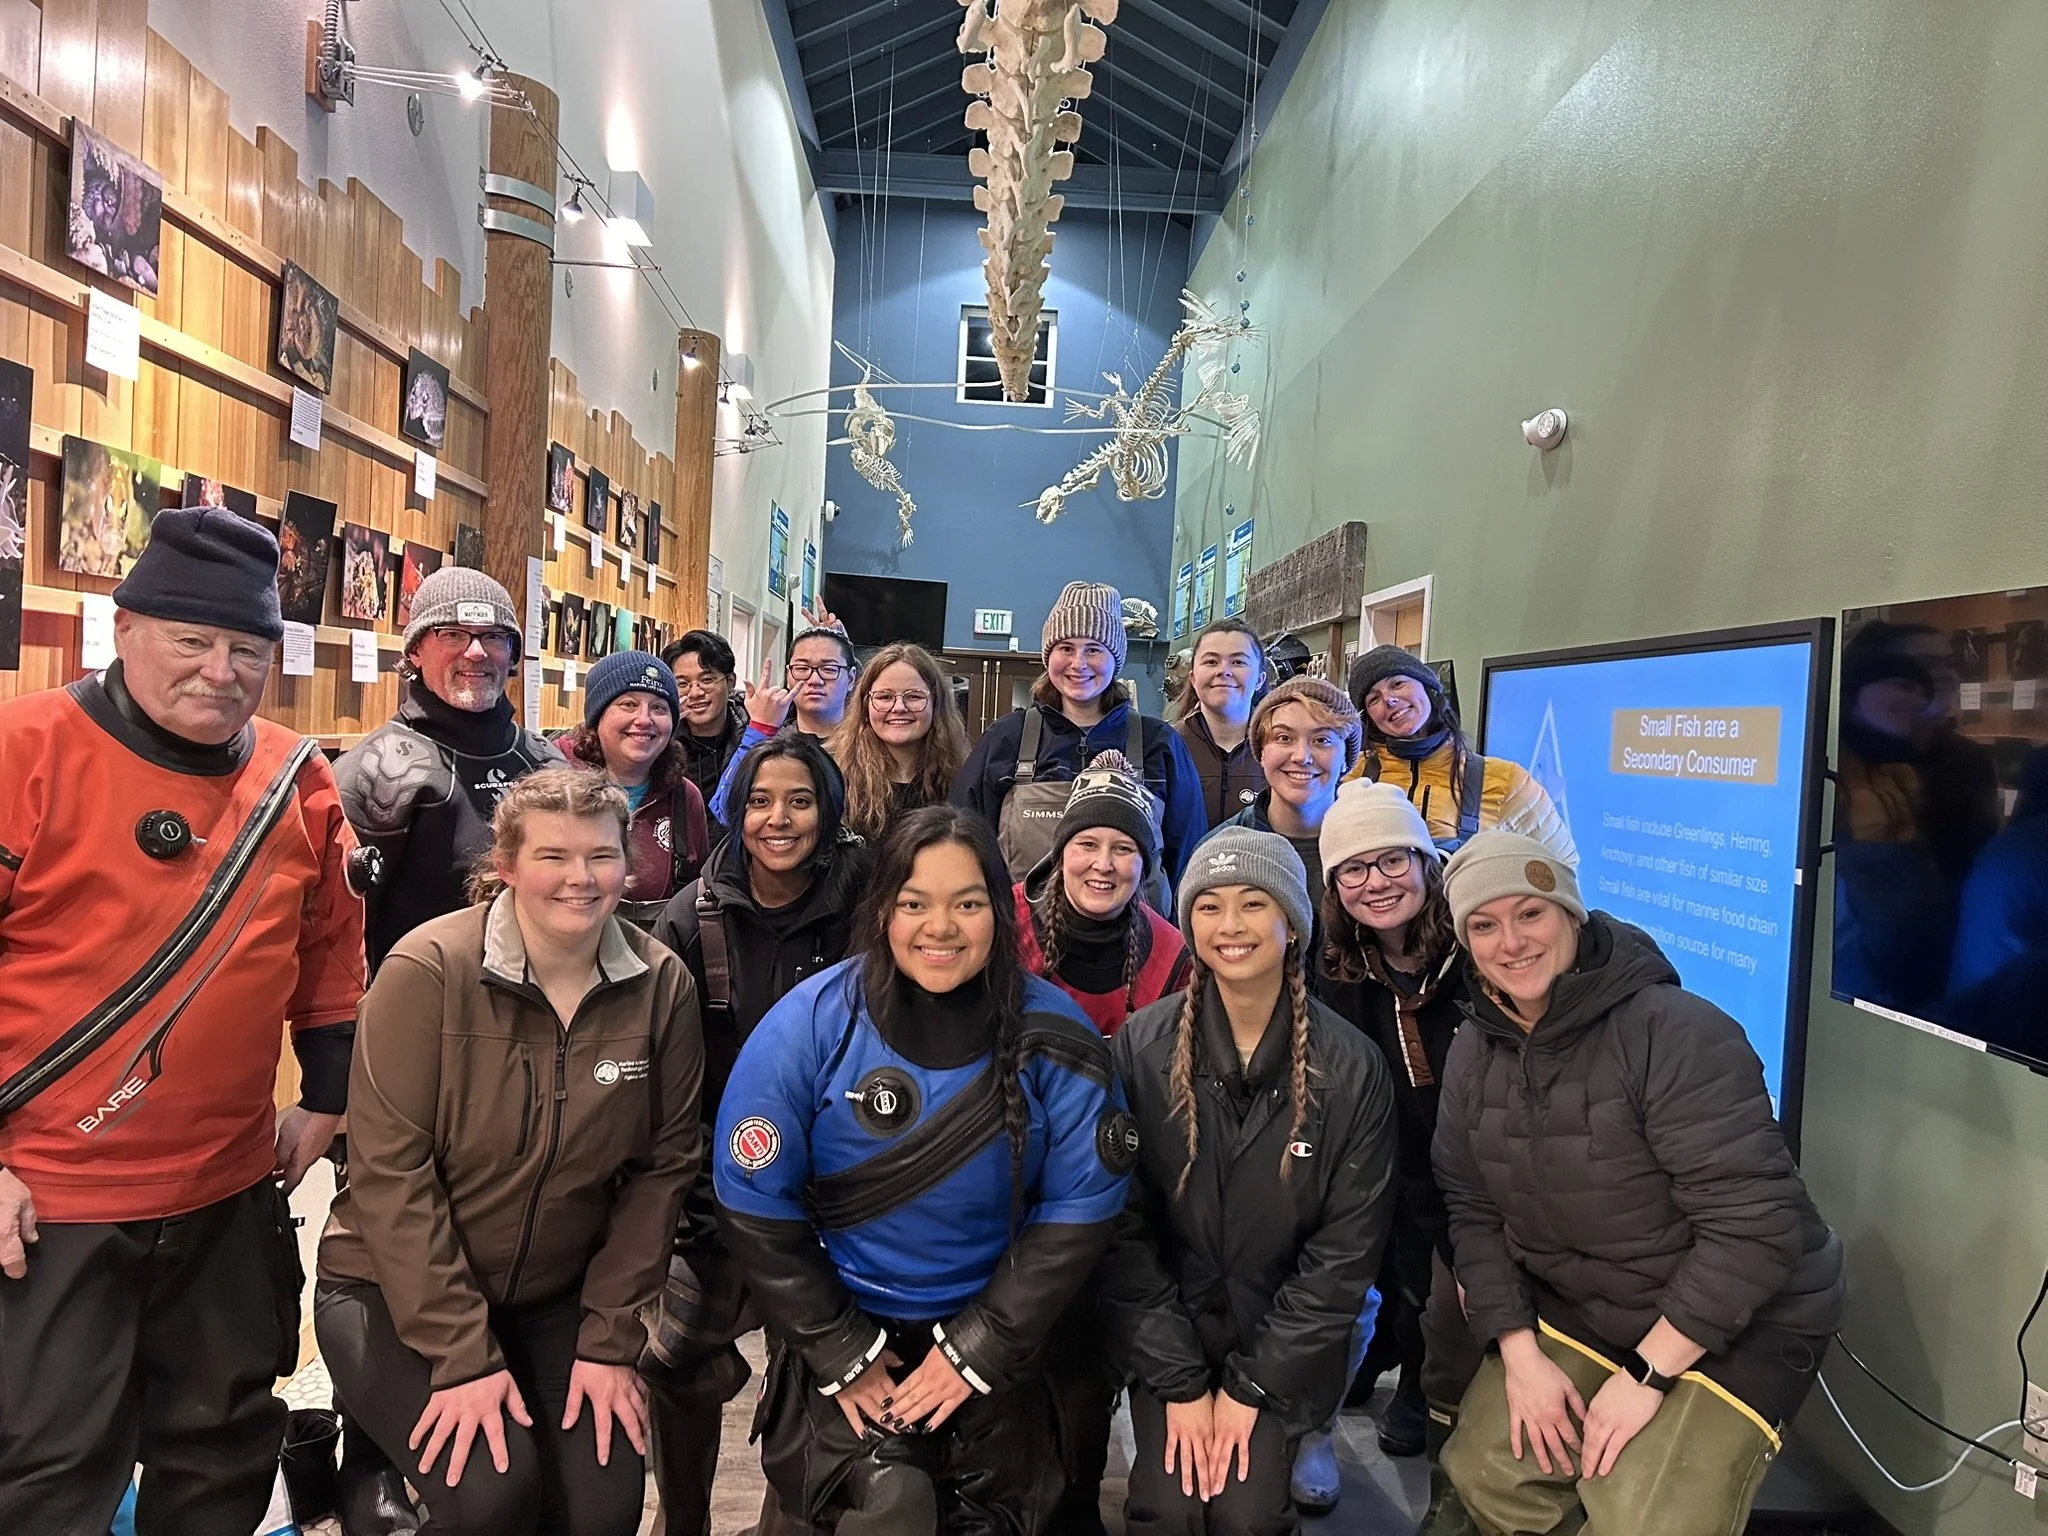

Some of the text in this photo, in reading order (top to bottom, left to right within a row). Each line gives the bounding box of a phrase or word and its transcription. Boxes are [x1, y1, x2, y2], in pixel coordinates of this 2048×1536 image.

[982, 612, 1006, 631] EXIT
[641, 675, 662, 687] Feiro
[1640, 714, 1739, 739] Small Fish are a
[1623, 747, 1758, 776] Secondary Consumer
[474, 781, 519, 790] SCUBAPRO
[1022, 809, 1064, 819] SIMMS
[1603, 811, 1773, 858] Small fish include Greenlings, Herring,
[1209, 865, 1237, 875] adidas
[1637, 852, 1653, 870] and
[1655, 855, 1677, 874] other
[1679, 857, 1697, 877] fish
[1698, 863, 1708, 879] of
[1710, 865, 1743, 890] similar
[1746, 874, 1771, 895] size.
[1599, 876, 1778, 937] Small fish are vital for marine food chain
[1677, 935, 1708, 957] source
[1711, 937, 1724, 960] for
[1727, 948, 1758, 976] many
[76, 1076, 147, 1134] BARE
[746, 1131, 765, 1156] SANTI
